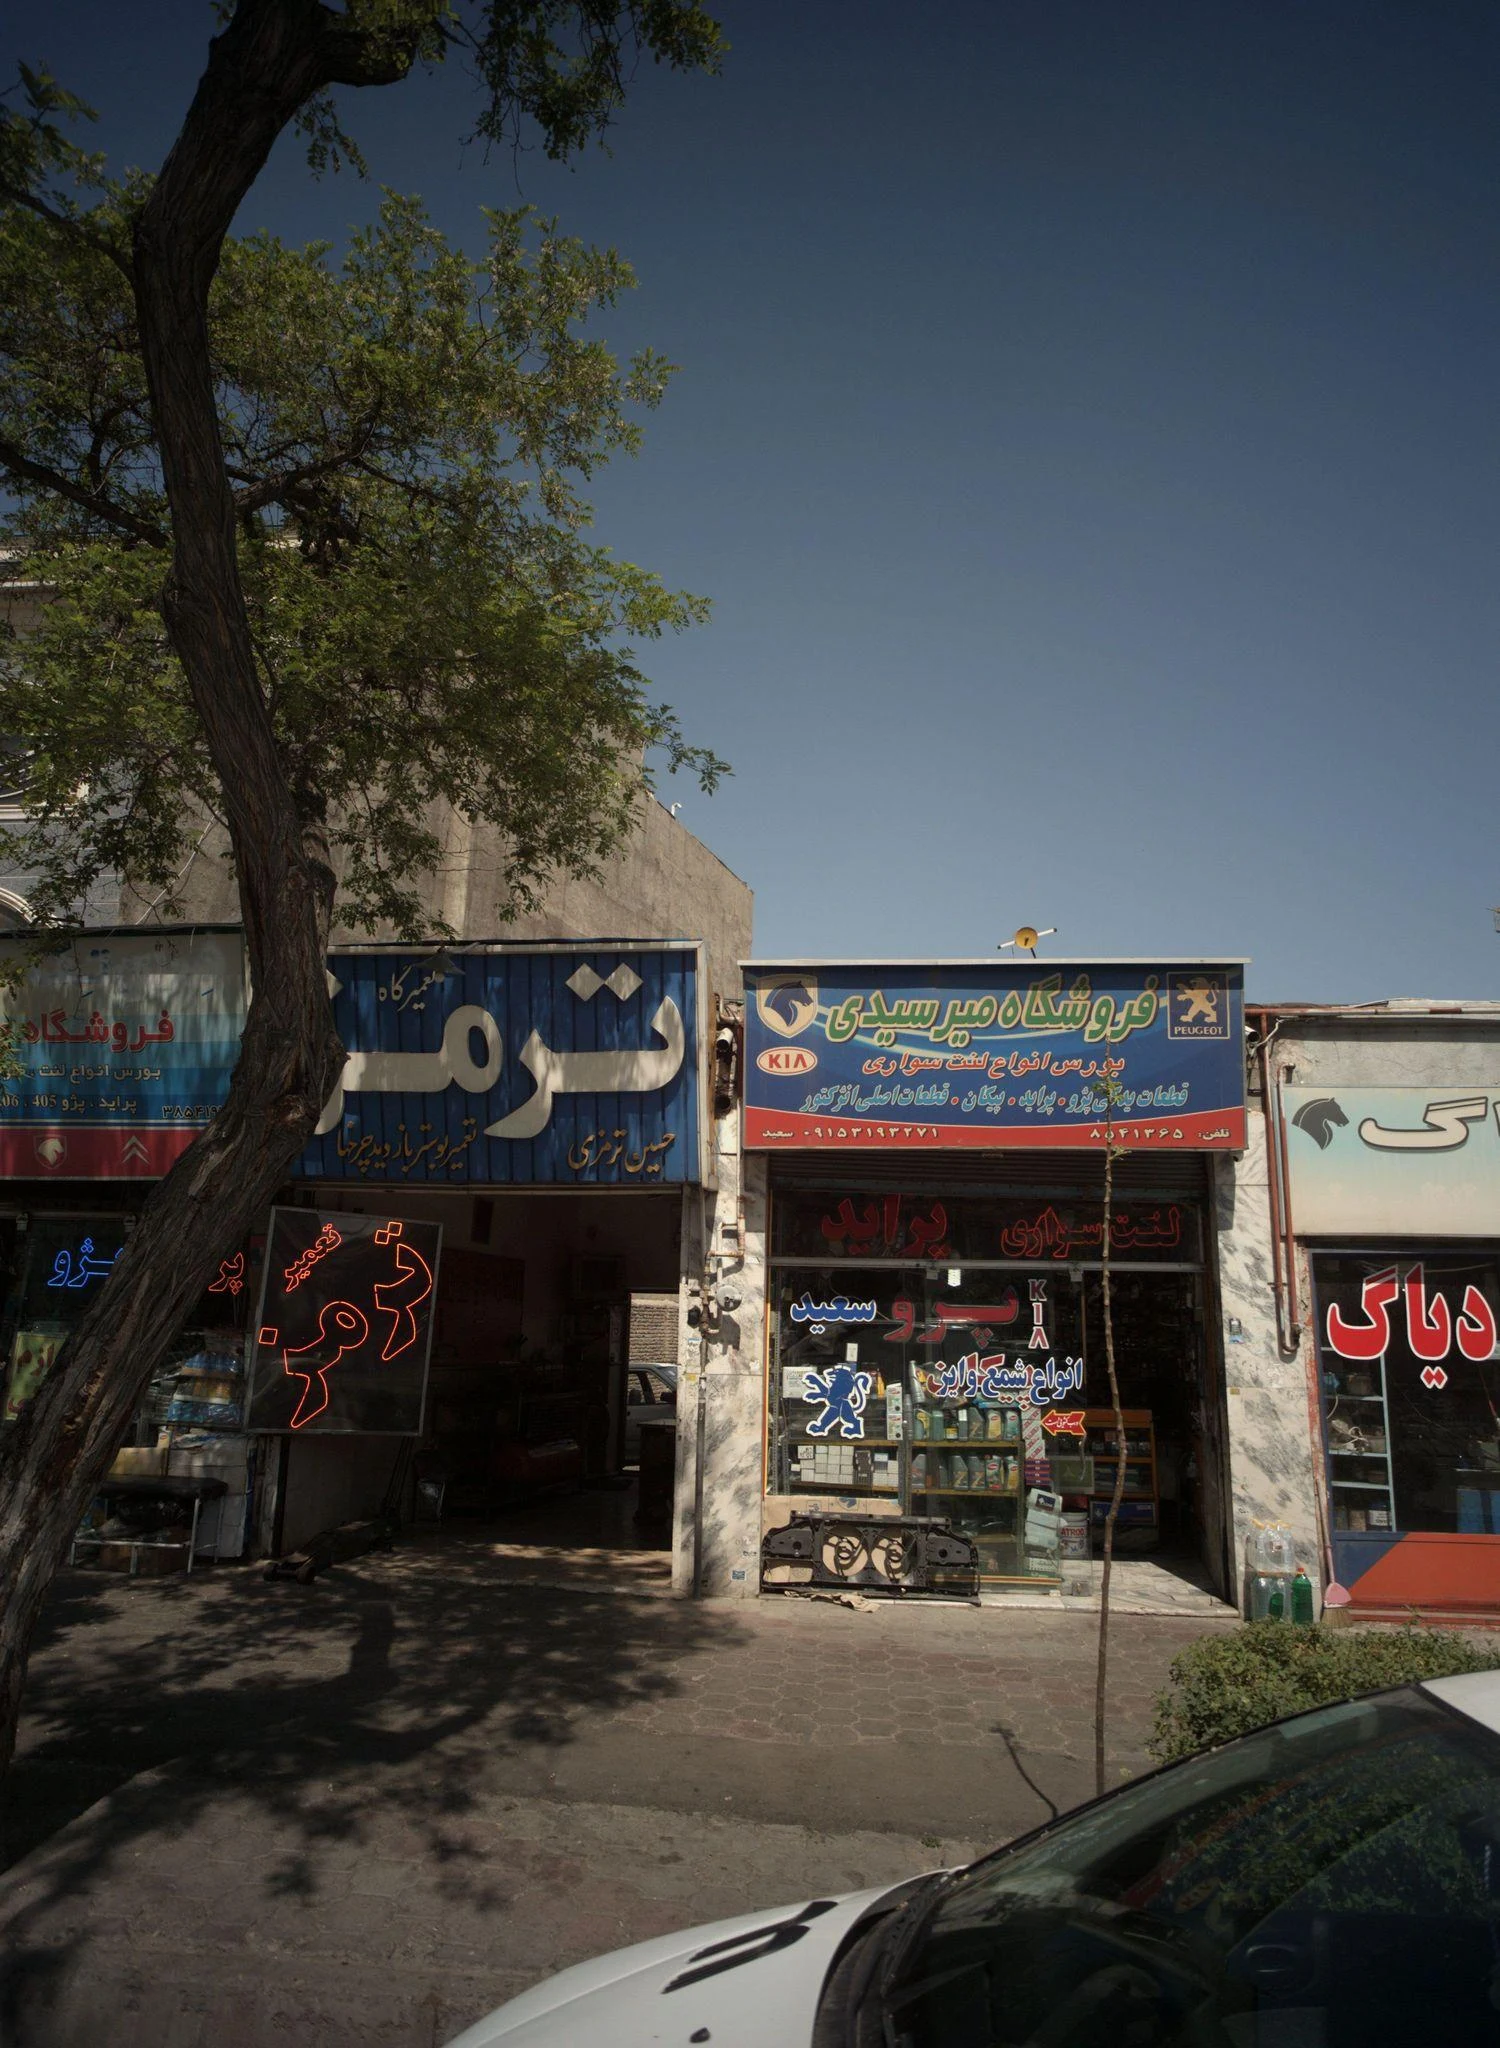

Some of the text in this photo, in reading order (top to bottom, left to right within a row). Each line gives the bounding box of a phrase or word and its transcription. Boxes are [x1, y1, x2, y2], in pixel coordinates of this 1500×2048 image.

[997, 973, 1158, 1043] فروشگاه
[25, 1009, 176, 1054] فروشگاه
[1173, 1026, 1224, 1036] PEUGEOT
[39, 1064, 66, 1077] لنت
[70, 1064, 109, 1084] انواع
[768, 1054, 808, 1070] KIA
[862, 1051, 1125, 1079] بورس انواع لنت سواری
[32, 1095, 57, 1108] 405
[61, 1094, 85, 1114] پژو
[98, 1095, 137, 1115] پراید
[854, 1084, 902, 1112] اصلی
[898, 1083, 951, 1107] قطعات
[961, 1084, 1005, 1116] پیکان
[1018, 1085, 1057, 1116] پراید
[1064, 1086, 1095, 1116] پژو
[1135, 1082, 1190, 1108] قطعات
[439, 1116, 479, 1171] تعمیر
[762, 1129, 794, 1139] سعید
[1197, 1128, 1230, 1141] تلفن:
[566, 1129, 678, 1174] حسین ترمزی
[821, 1193, 951, 1258] پراید
[1000, 1204, 1181, 1258] لنت سواری
[47, 1236, 124, 1288] ژو
[283, 1223, 342, 1293] تعمیر
[258, 1221, 434, 1430] ترمز
[790, 1291, 877, 1335] سعید
[1028, 1279, 1049, 1350] KIA
[1326, 1262, 1497, 1390] دیاگ
[1029, 1356, 1083, 1406] انواع
